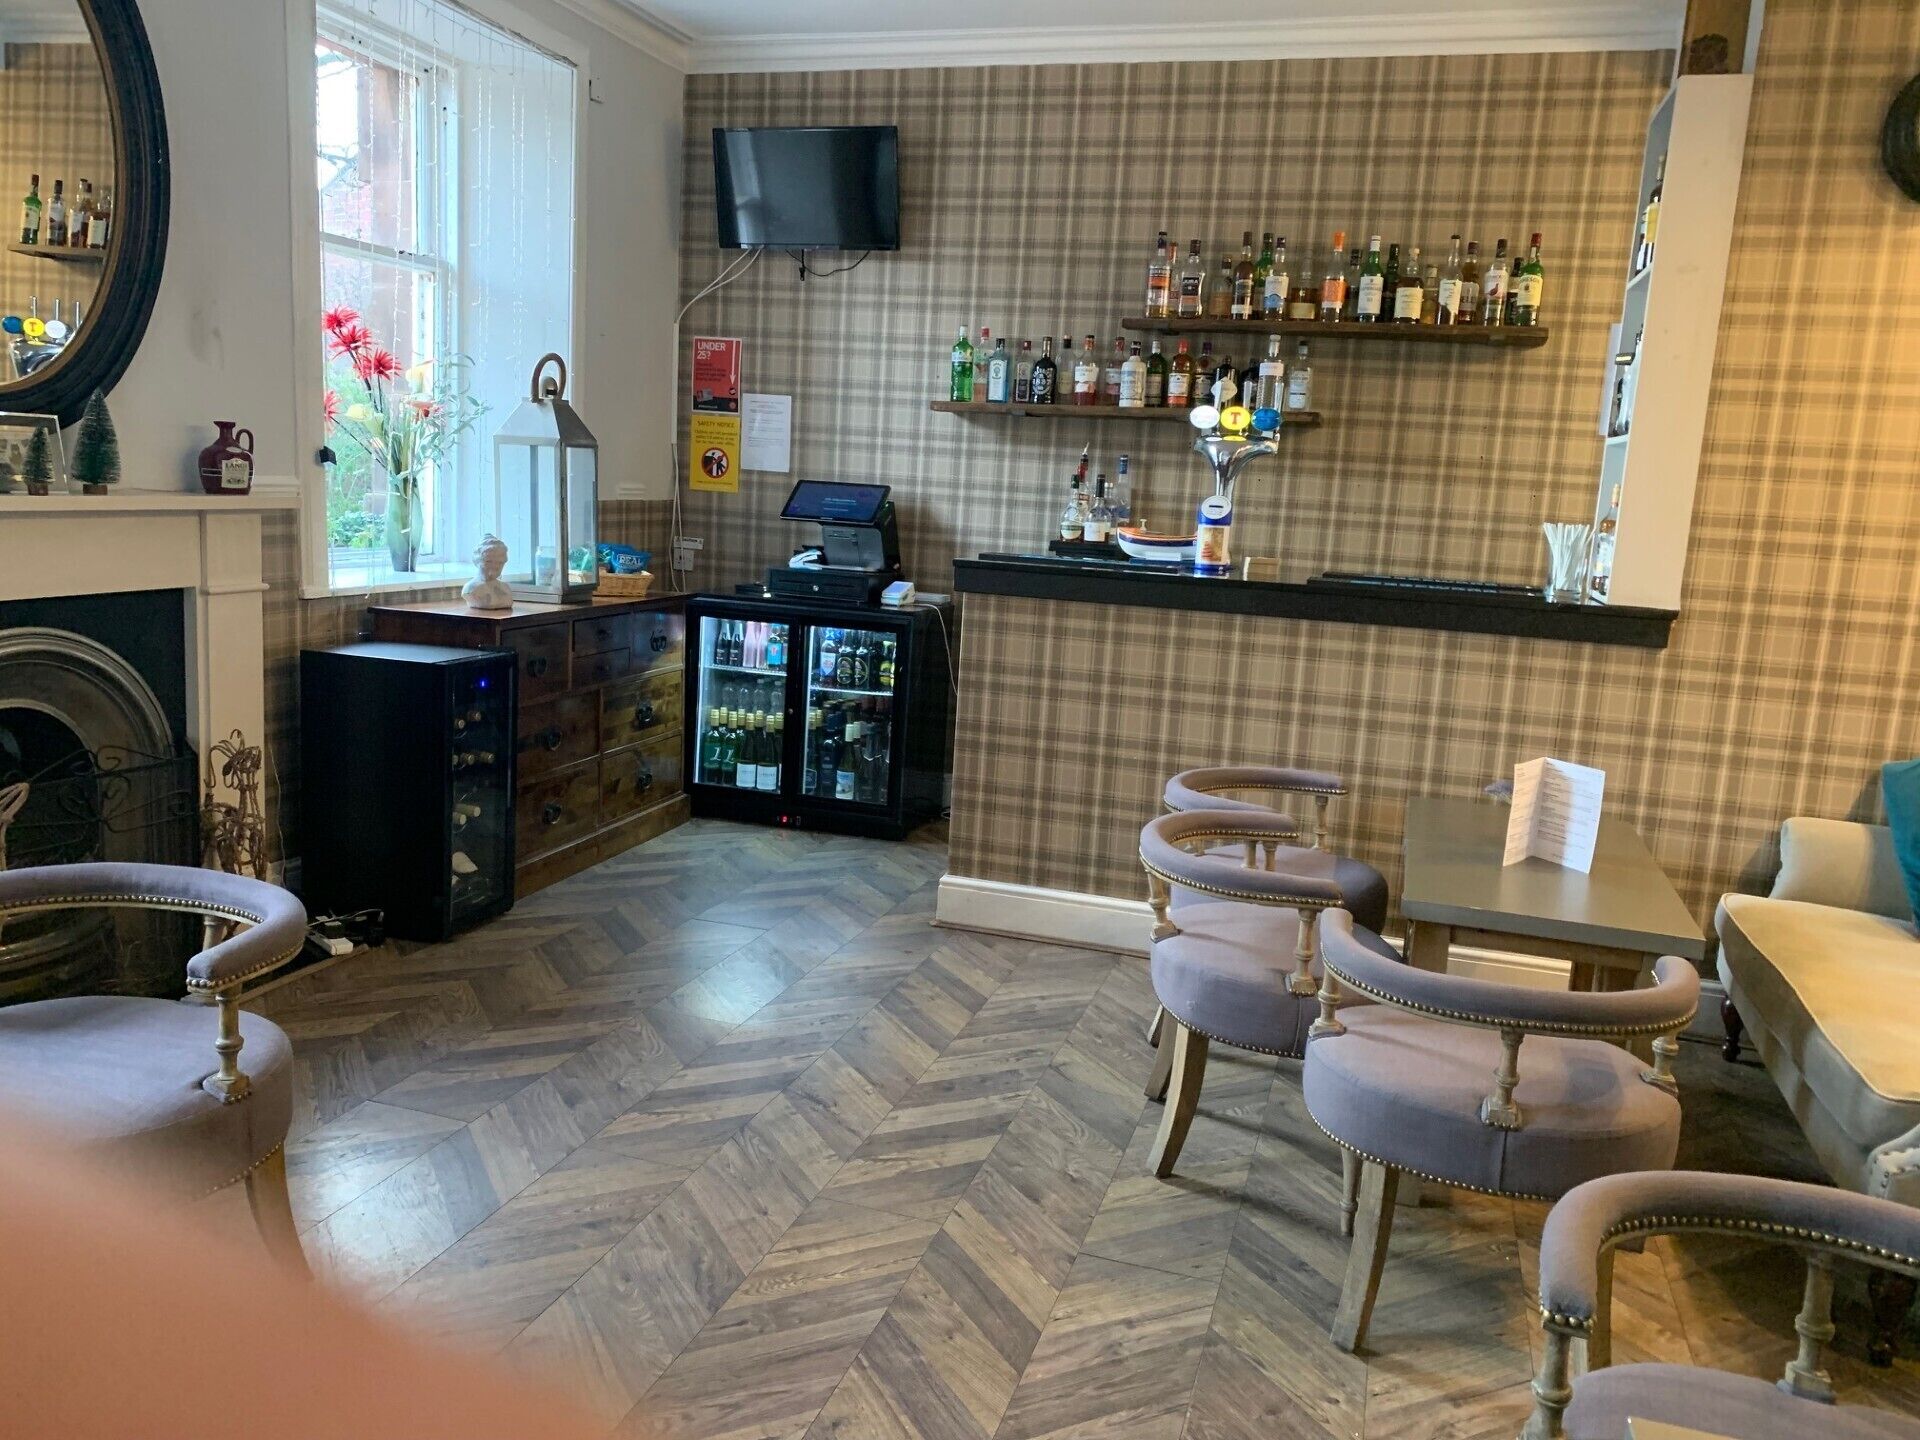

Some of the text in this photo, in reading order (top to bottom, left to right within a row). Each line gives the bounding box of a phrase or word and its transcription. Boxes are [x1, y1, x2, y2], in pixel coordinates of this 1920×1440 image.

[697, 342, 726, 351] UNDER
[697, 350, 711, 360] 25?
[1231, 411, 1241, 425] T
[619, 556, 642, 565] REAL
